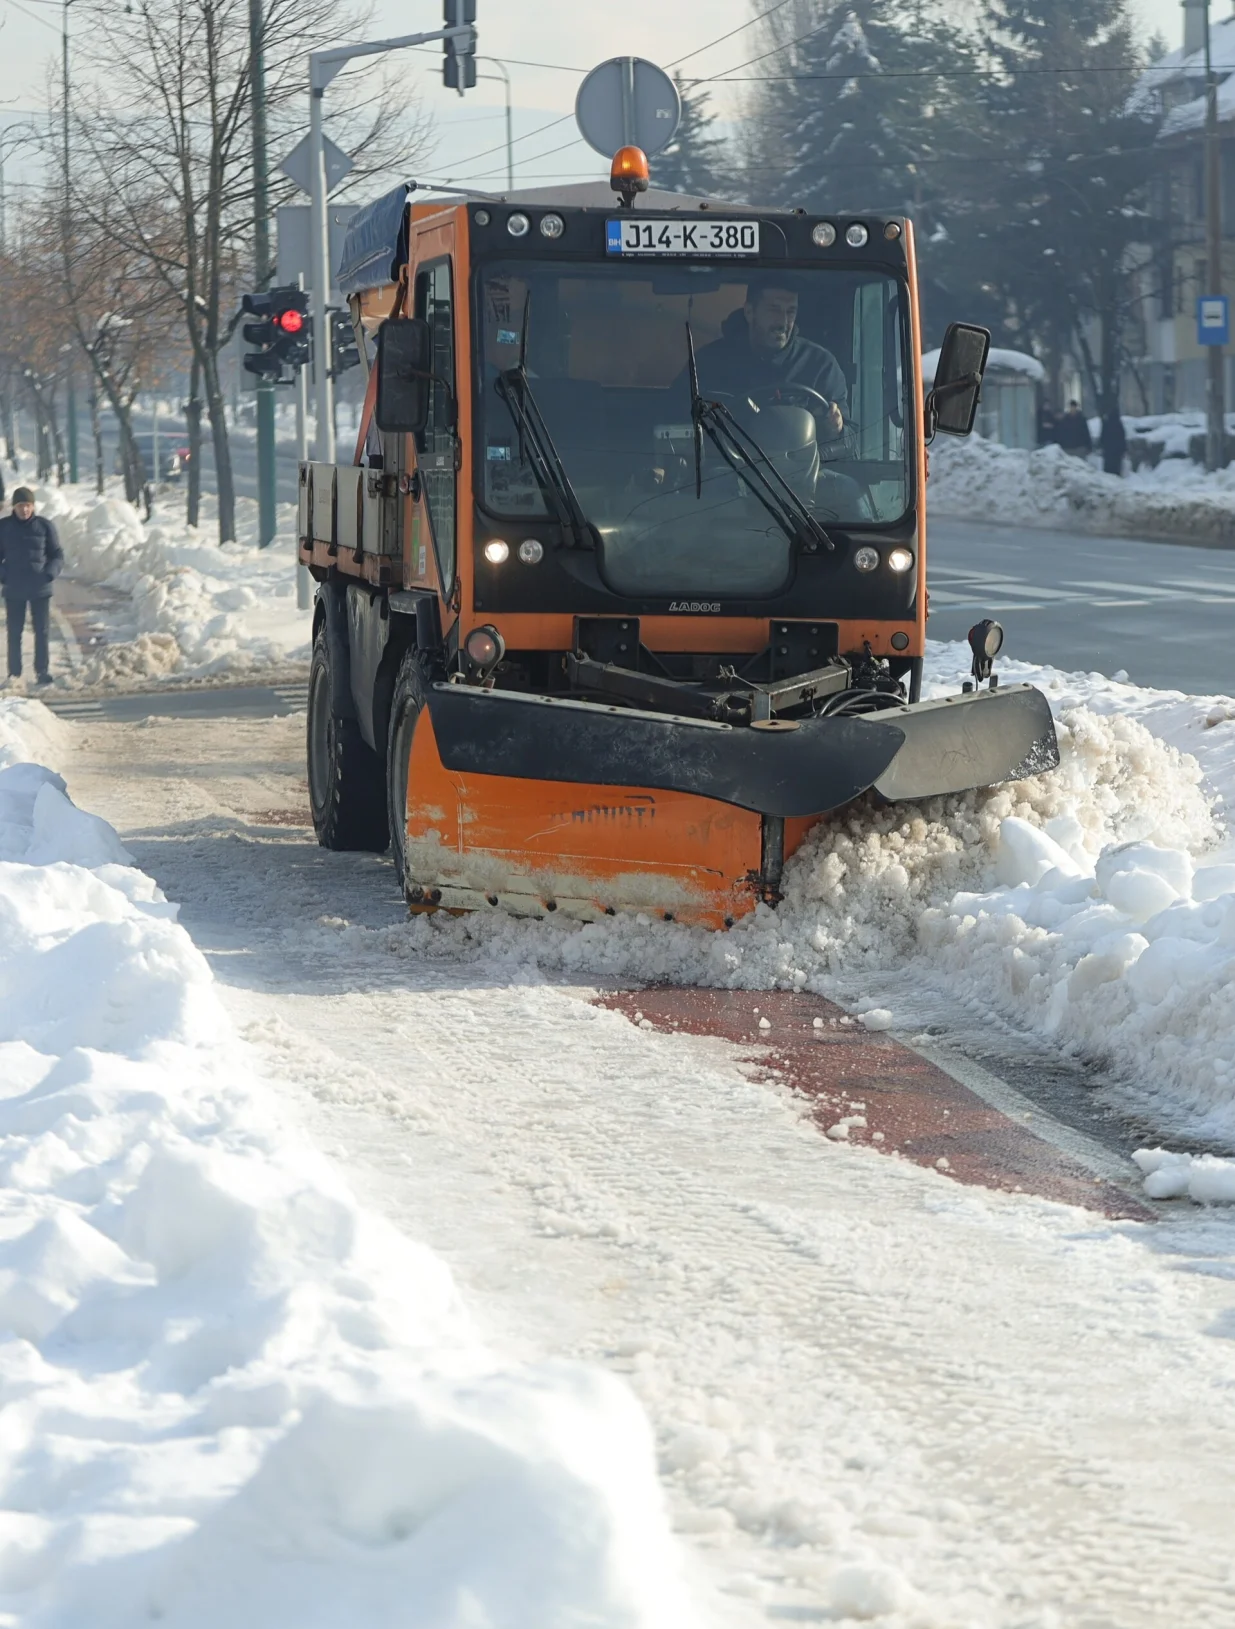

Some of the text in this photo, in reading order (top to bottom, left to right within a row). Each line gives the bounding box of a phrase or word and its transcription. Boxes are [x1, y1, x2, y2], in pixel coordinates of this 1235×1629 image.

[608, 238, 621, 247] BIH
[625, 224, 755, 249] J14-K-380
[668, 601, 721, 613] LADOG
